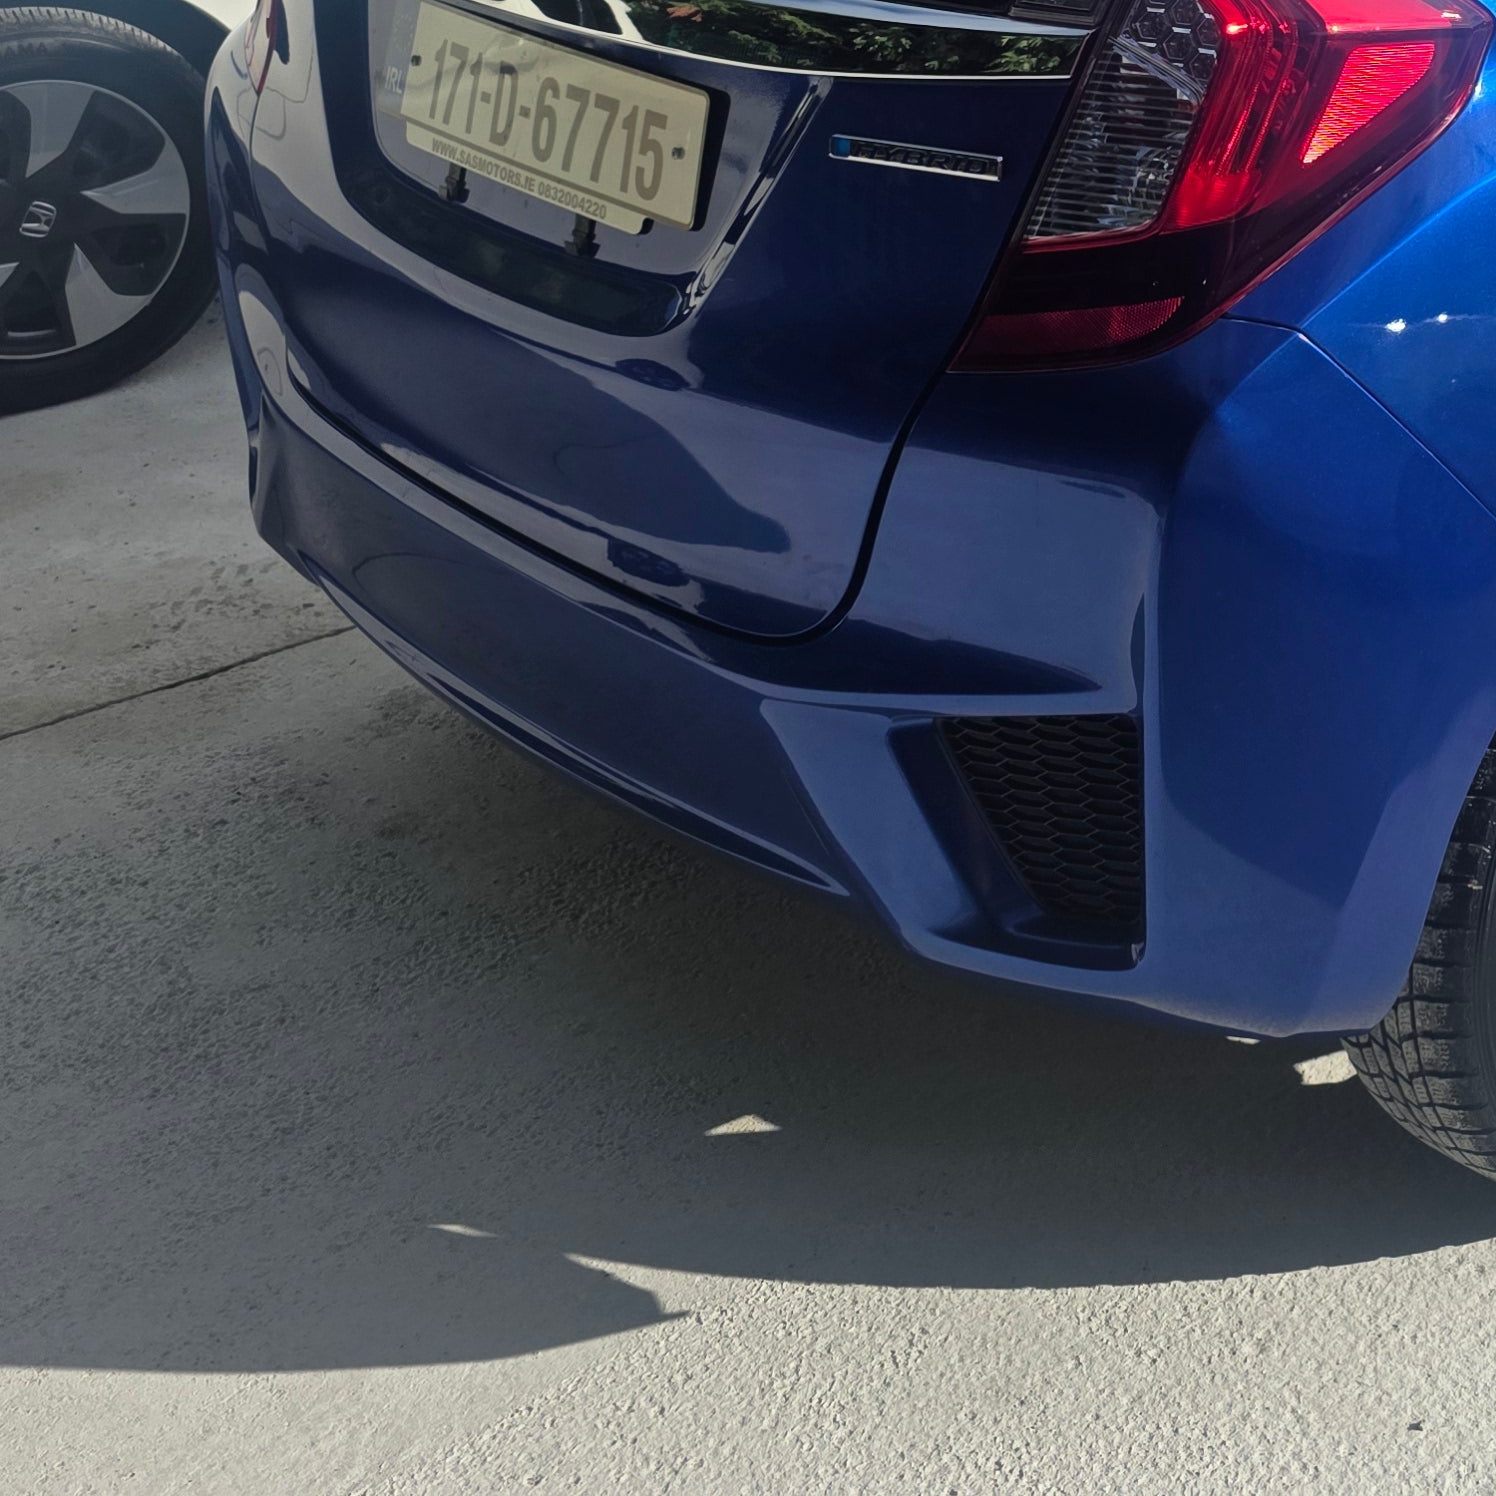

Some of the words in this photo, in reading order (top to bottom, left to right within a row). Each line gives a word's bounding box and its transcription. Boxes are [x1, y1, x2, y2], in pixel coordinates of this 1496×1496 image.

[384, 64, 403, 94] IRL
[428, 38, 668, 201] 171-D-67715
[431, 136, 537, 192] WWW.SASMOTORS.IE
[537, 180, 607, 220] 0832004220
